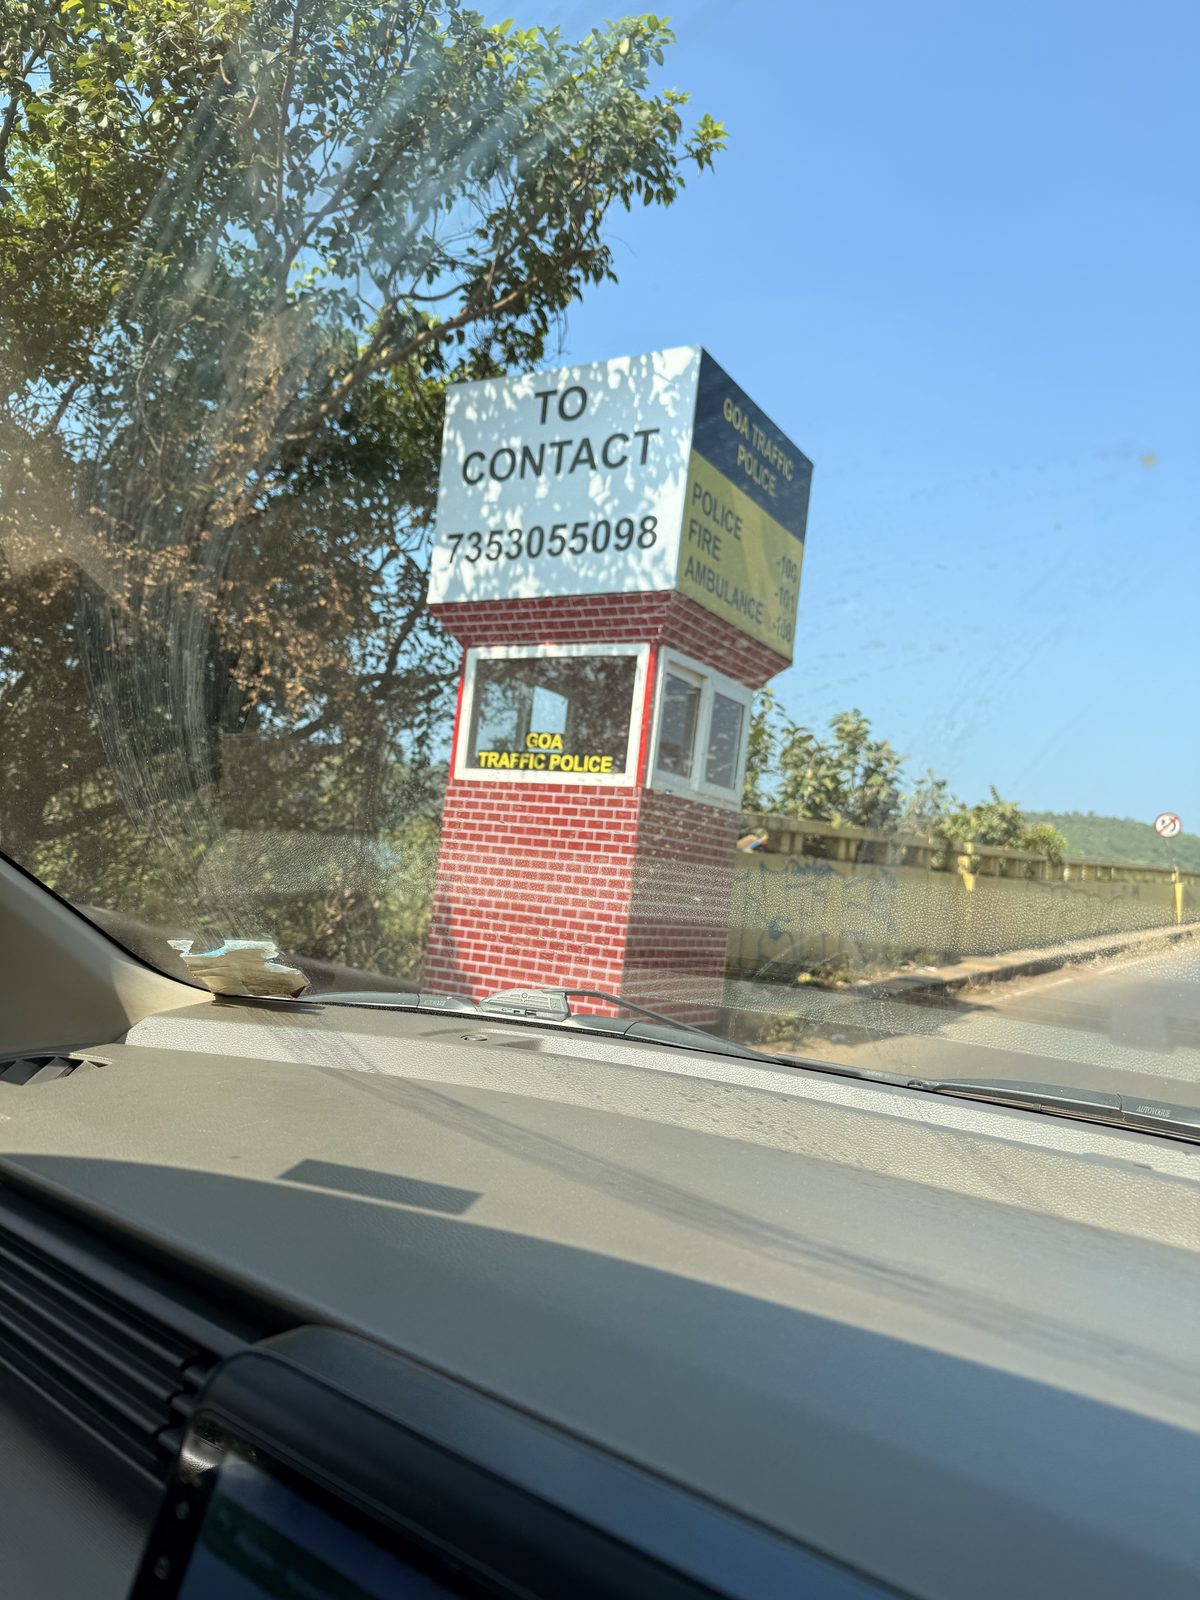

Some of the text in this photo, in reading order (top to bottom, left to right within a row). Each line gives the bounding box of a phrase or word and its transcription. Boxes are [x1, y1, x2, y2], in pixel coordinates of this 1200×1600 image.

[535, 386, 588, 425] TO
[462, 428, 660, 486] CONTACT
[723, 397, 794, 481] GOA TRAFFIC
[737, 444, 777, 497] POLICE
[692, 482, 743, 541] POLICE
[447, 515, 658, 564] 7353055098
[688, 518, 721, 562] FIRE
[684, 556, 763, 625] AMBULANCE
[479, 751, 613, 773] TRAFFIC POLICE
[526, 732, 563, 750] GOA
